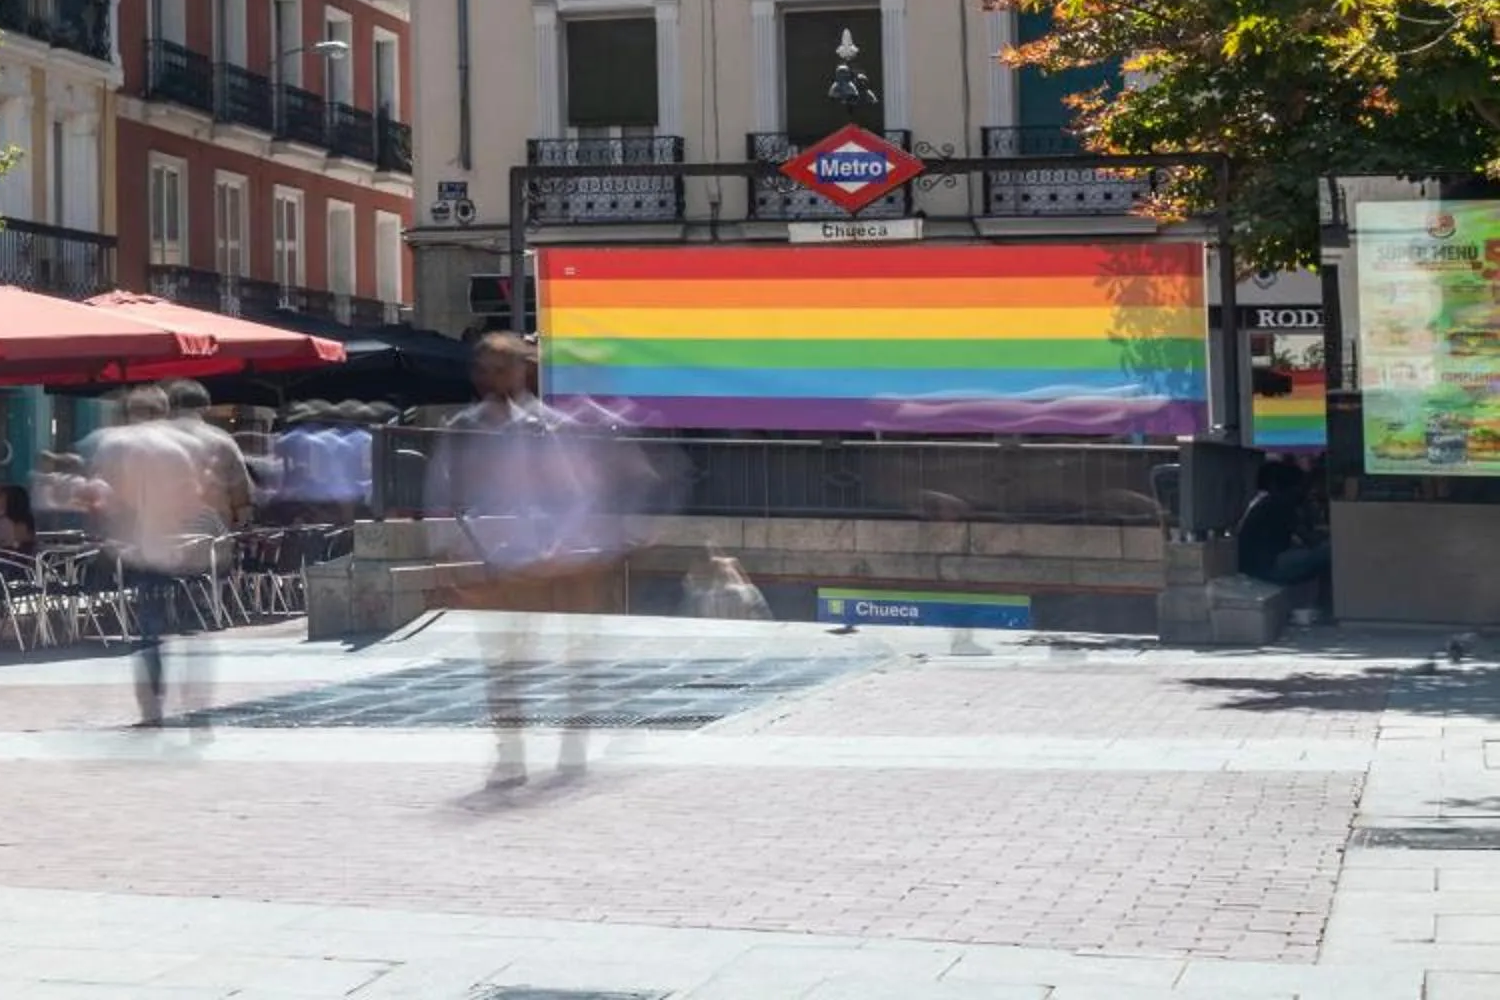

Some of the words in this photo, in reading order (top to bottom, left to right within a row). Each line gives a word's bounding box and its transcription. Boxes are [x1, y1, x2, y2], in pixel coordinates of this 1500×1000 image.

[820, 159, 883, 177] Metro
[821, 223, 888, 238] Chueca
[855, 601, 919, 618] Chueca
